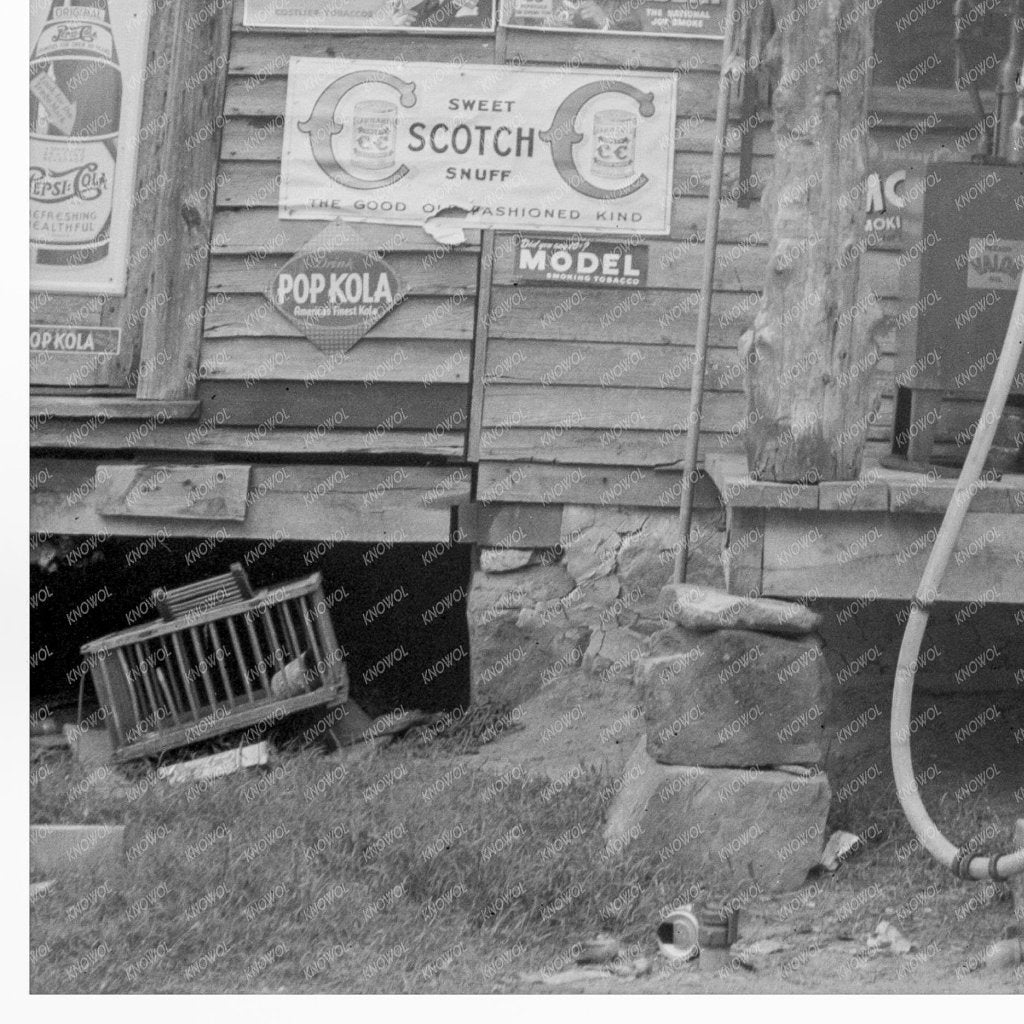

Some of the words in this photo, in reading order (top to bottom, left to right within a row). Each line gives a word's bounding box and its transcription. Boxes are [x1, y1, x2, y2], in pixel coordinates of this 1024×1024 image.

[448, 98, 516, 113] SWEET
[408, 122, 535, 158] SCOTCH
[446, 167, 513, 182] SNUFF
[309, 198, 342, 210] THE
[353, 200, 407, 213] GOOD
[596, 211, 643, 223] KIND
[519, 249, 640, 276] MODEL
[277, 273, 326, 304] POP
[328, 272, 393, 304] KOLA
[545, 272, 591, 282] SMOKING
[593, 276, 640, 286] TOBACCO
[53, 330, 95, 351] KOLA
